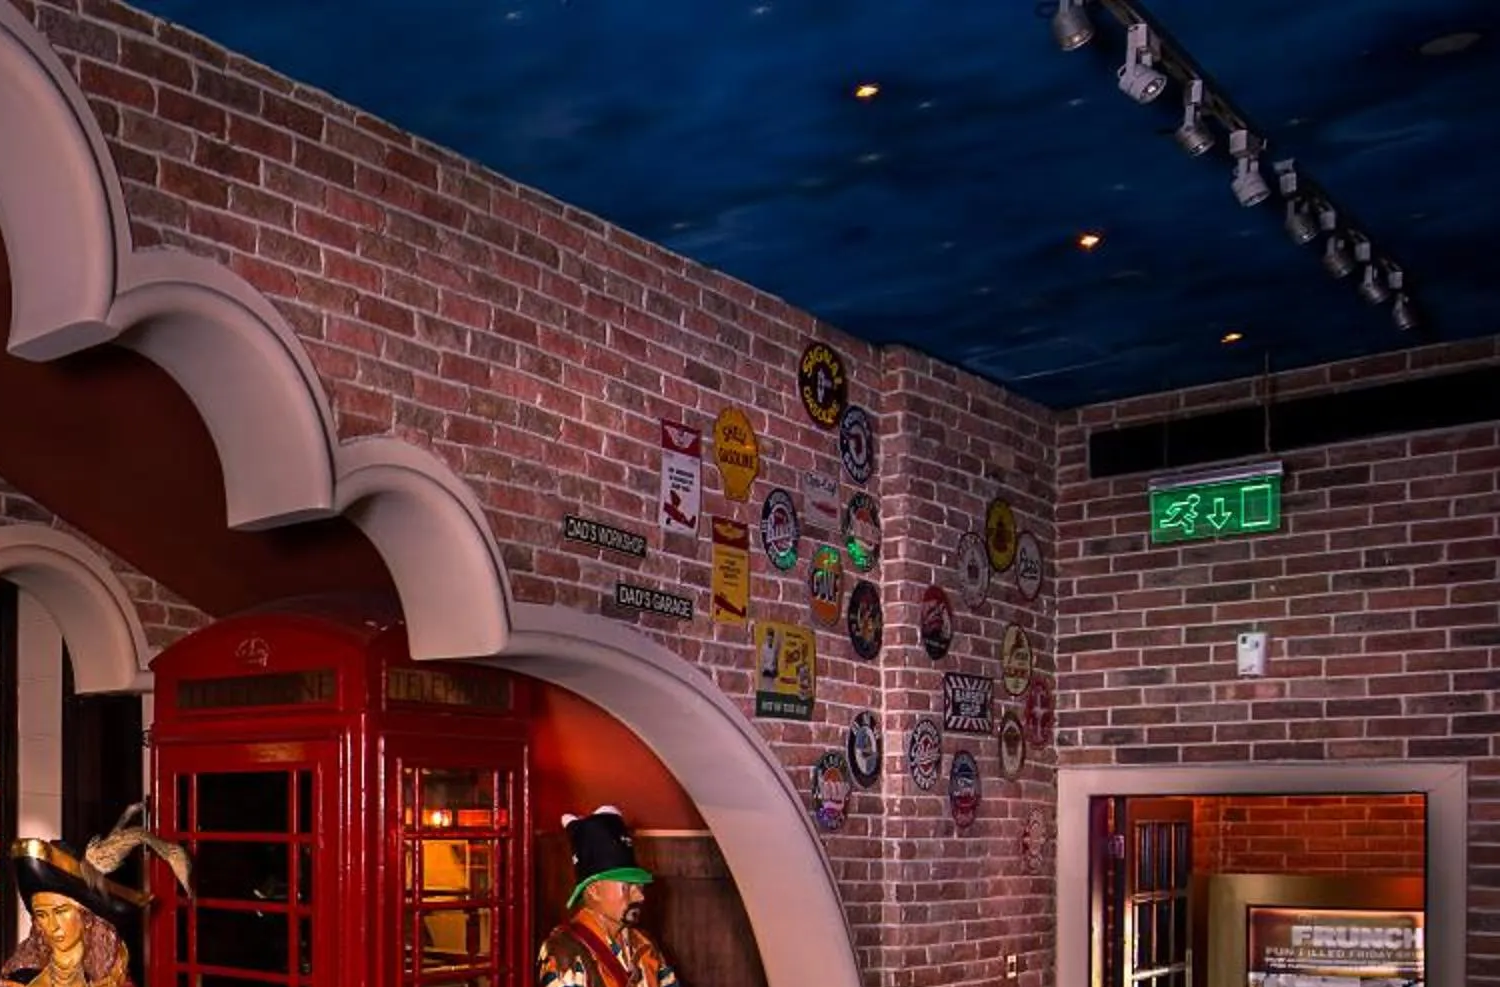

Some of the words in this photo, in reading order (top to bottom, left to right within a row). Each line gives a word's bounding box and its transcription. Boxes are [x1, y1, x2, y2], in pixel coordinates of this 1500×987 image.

[566, 518, 597, 542] DAD'S
[599, 526, 645, 554] WORKSHOP
[619, 586, 651, 609] DAD'S
[653, 593, 692, 616] GARAGE
[1291, 925, 1425, 949] FRUNCH
